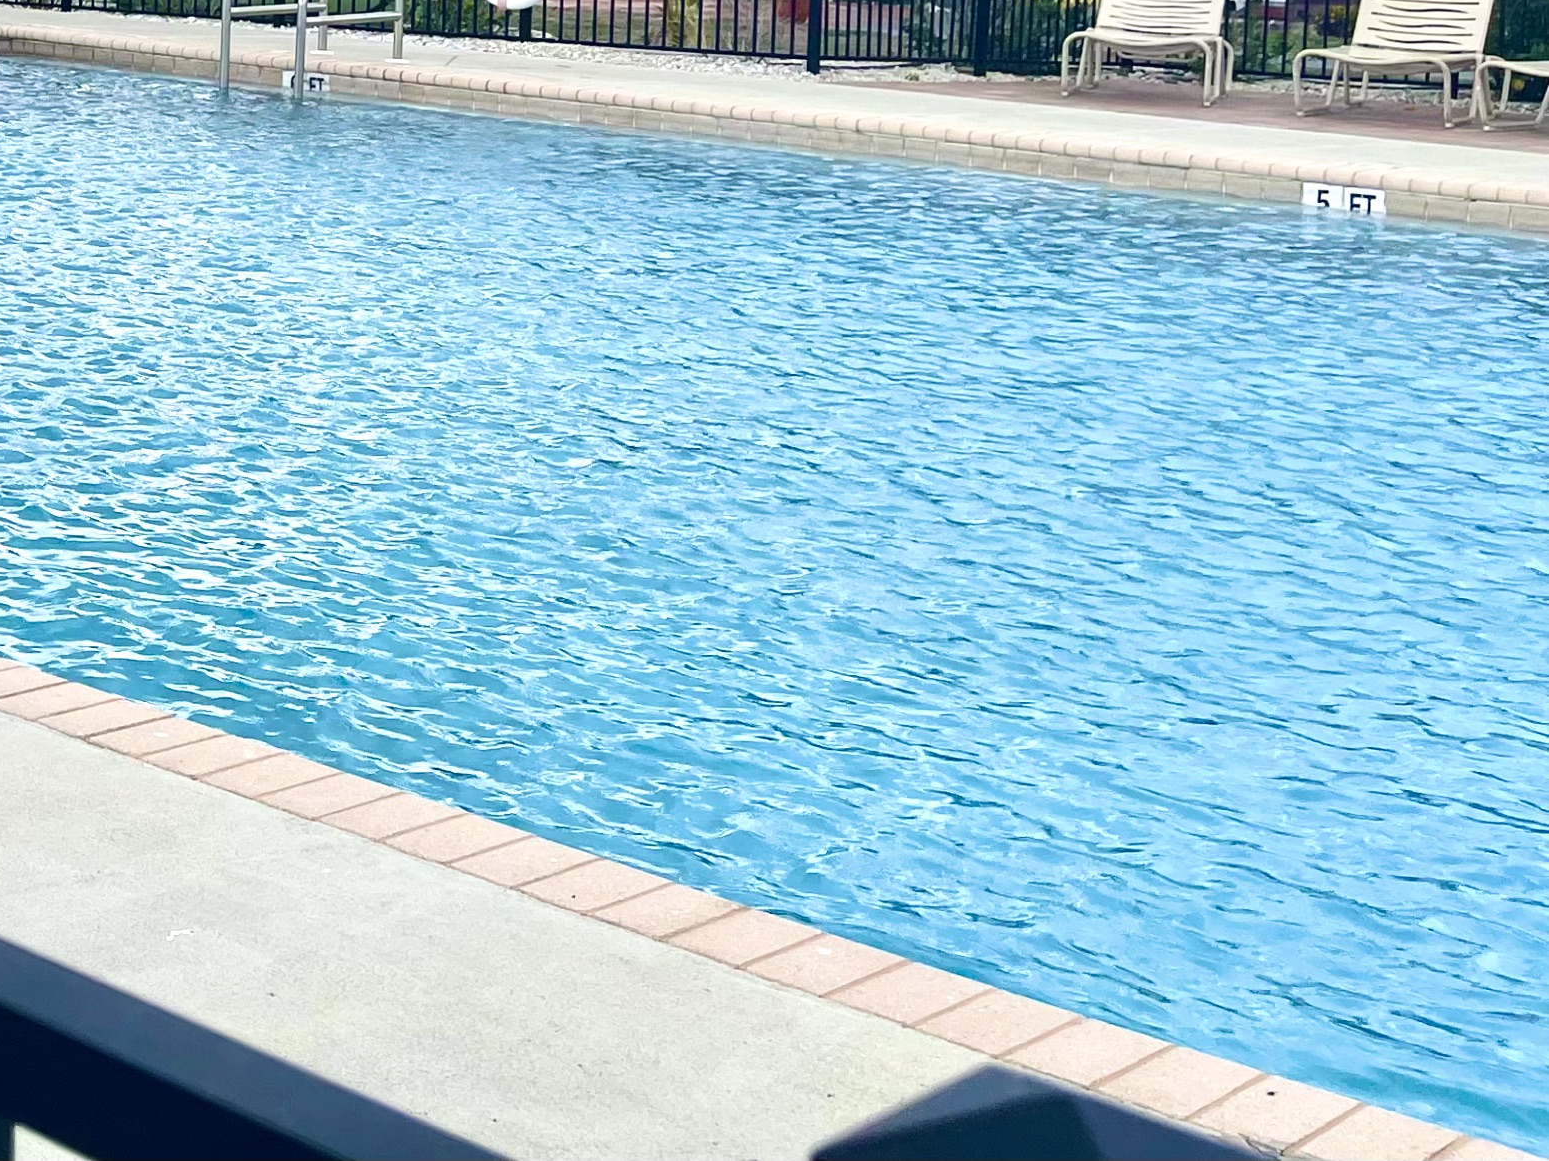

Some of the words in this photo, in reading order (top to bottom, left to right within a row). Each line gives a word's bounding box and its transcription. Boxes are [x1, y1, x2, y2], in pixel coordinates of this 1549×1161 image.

[309, 76, 325, 92] FT
[1317, 189, 1330, 208] 5
[1349, 192, 1377, 215] FT
